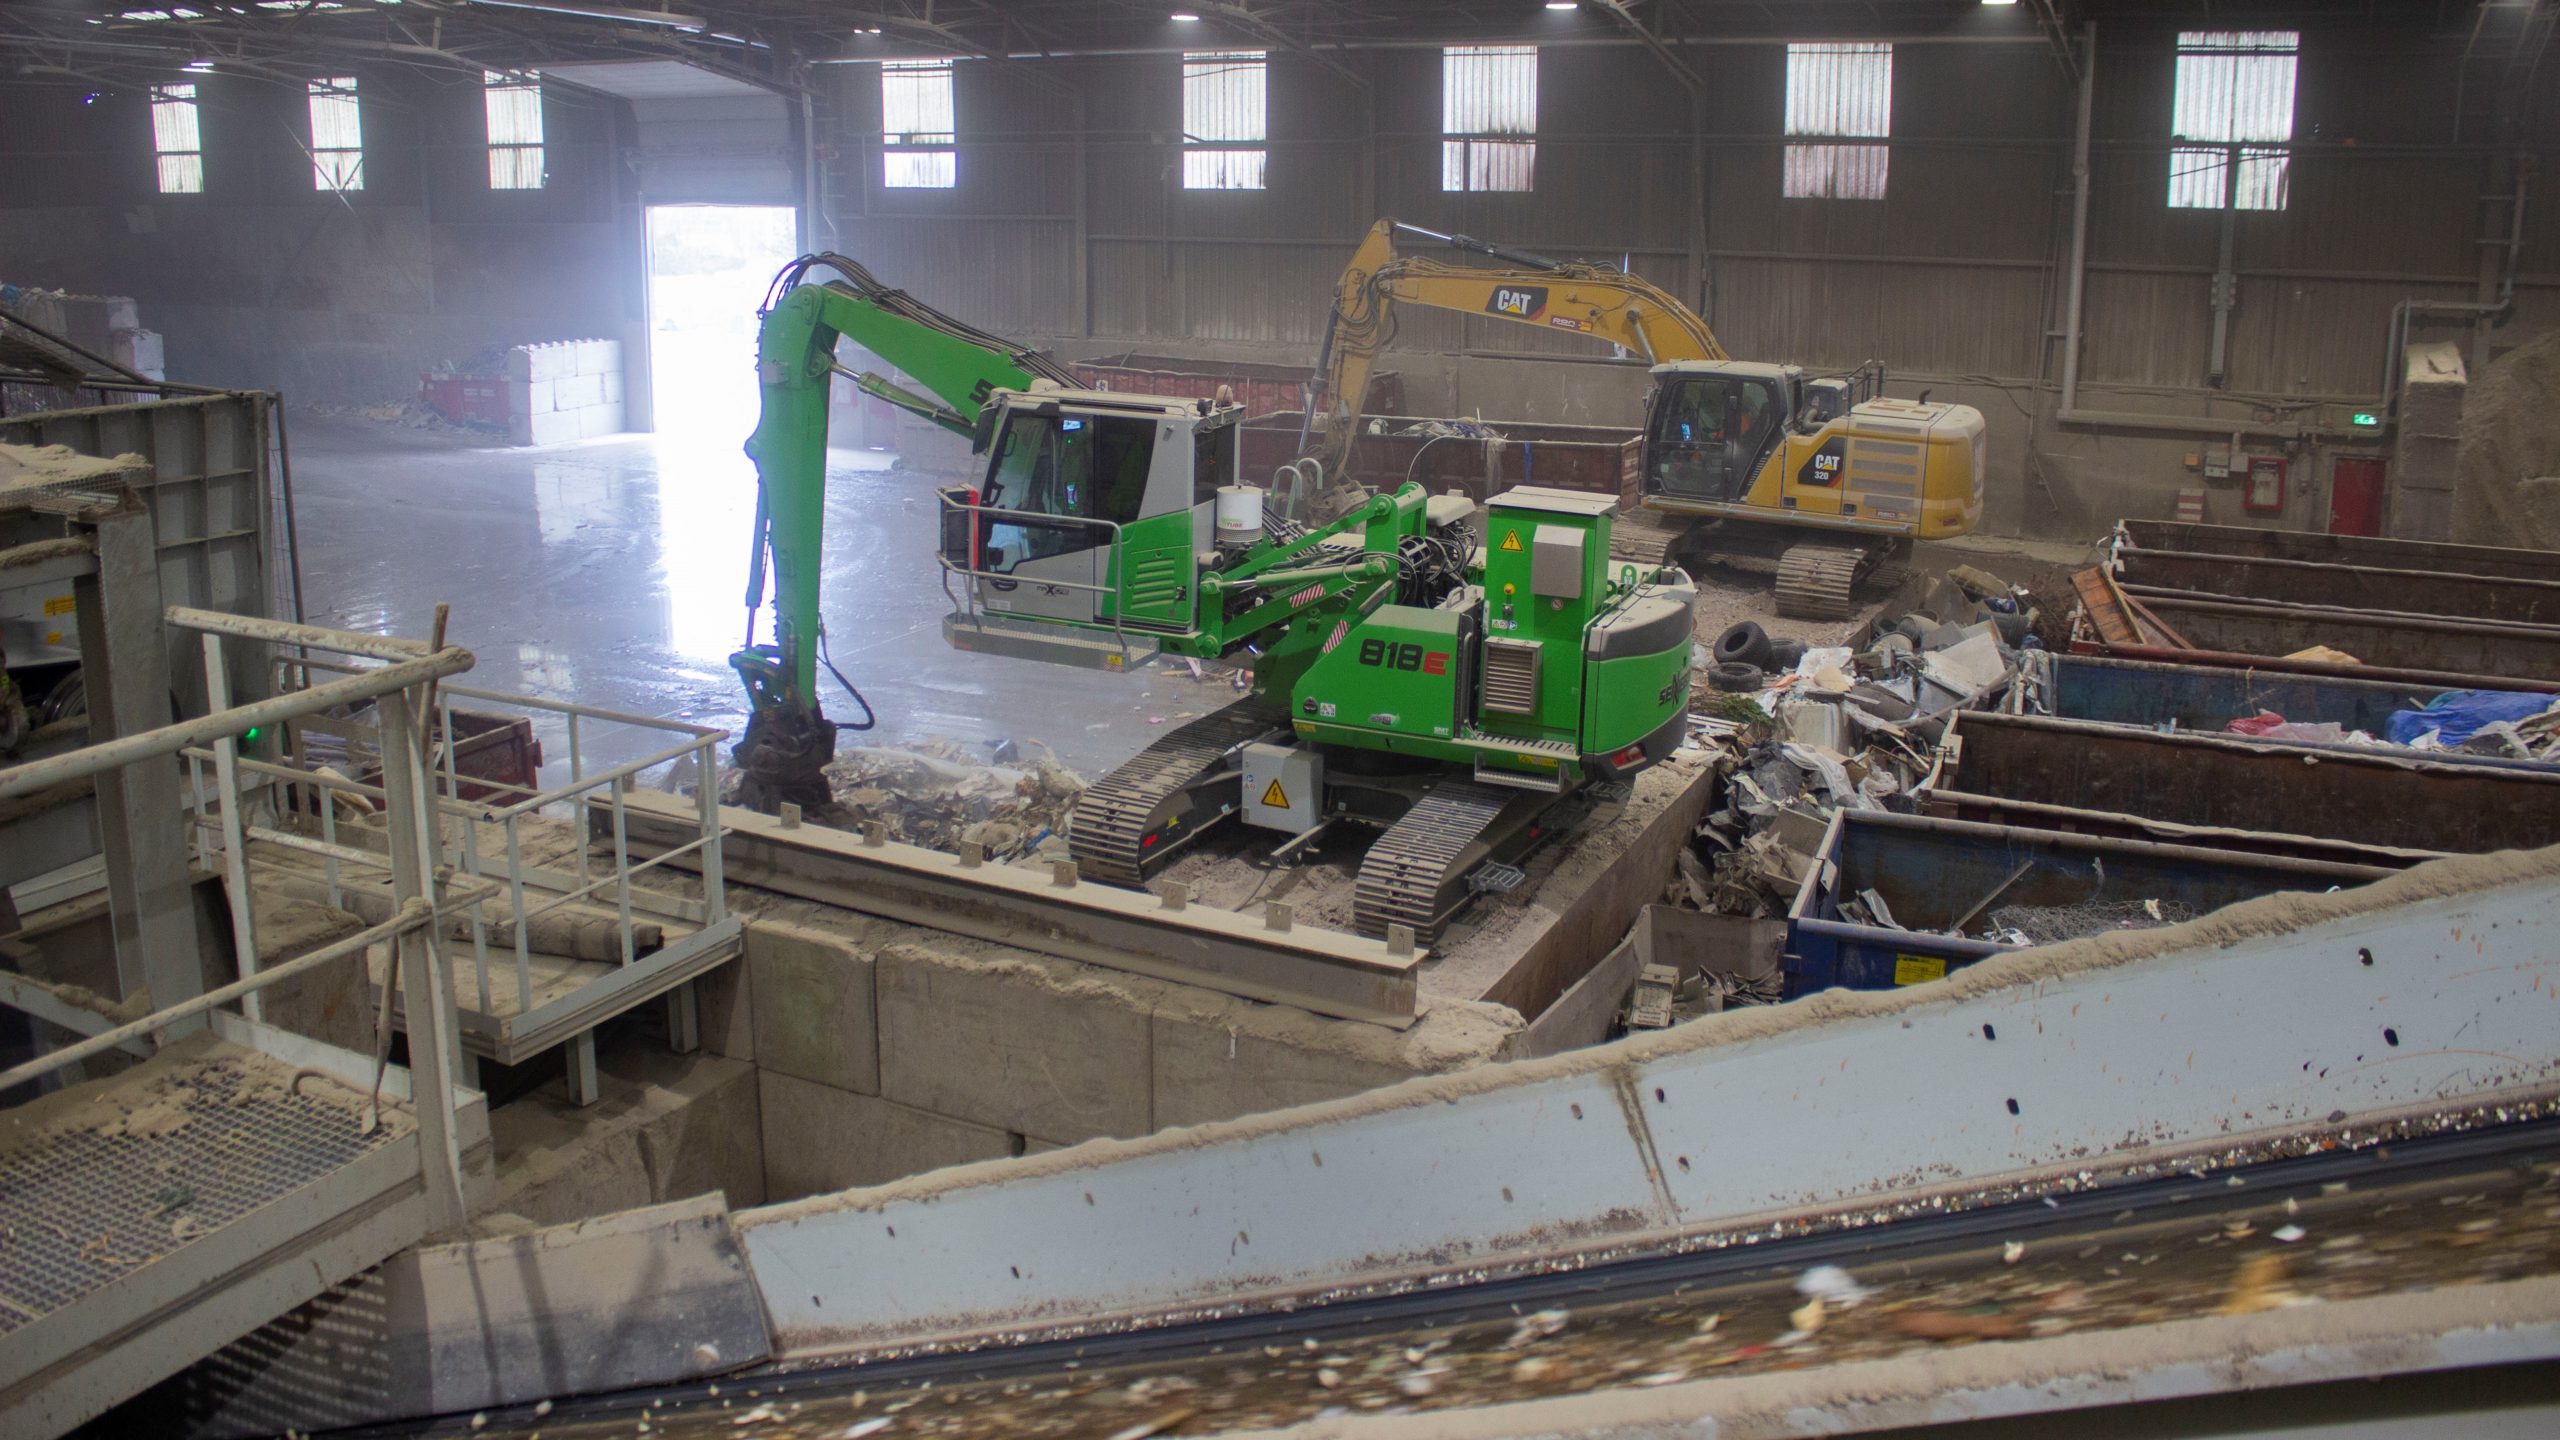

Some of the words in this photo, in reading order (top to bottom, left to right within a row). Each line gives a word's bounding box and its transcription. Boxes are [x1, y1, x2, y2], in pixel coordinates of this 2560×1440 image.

[1497, 290, 1532, 314] CAT
[1815, 454, 1840, 471] CAT
[1814, 471, 1829, 480] 320
[1359, 638, 1450, 676] 818E
